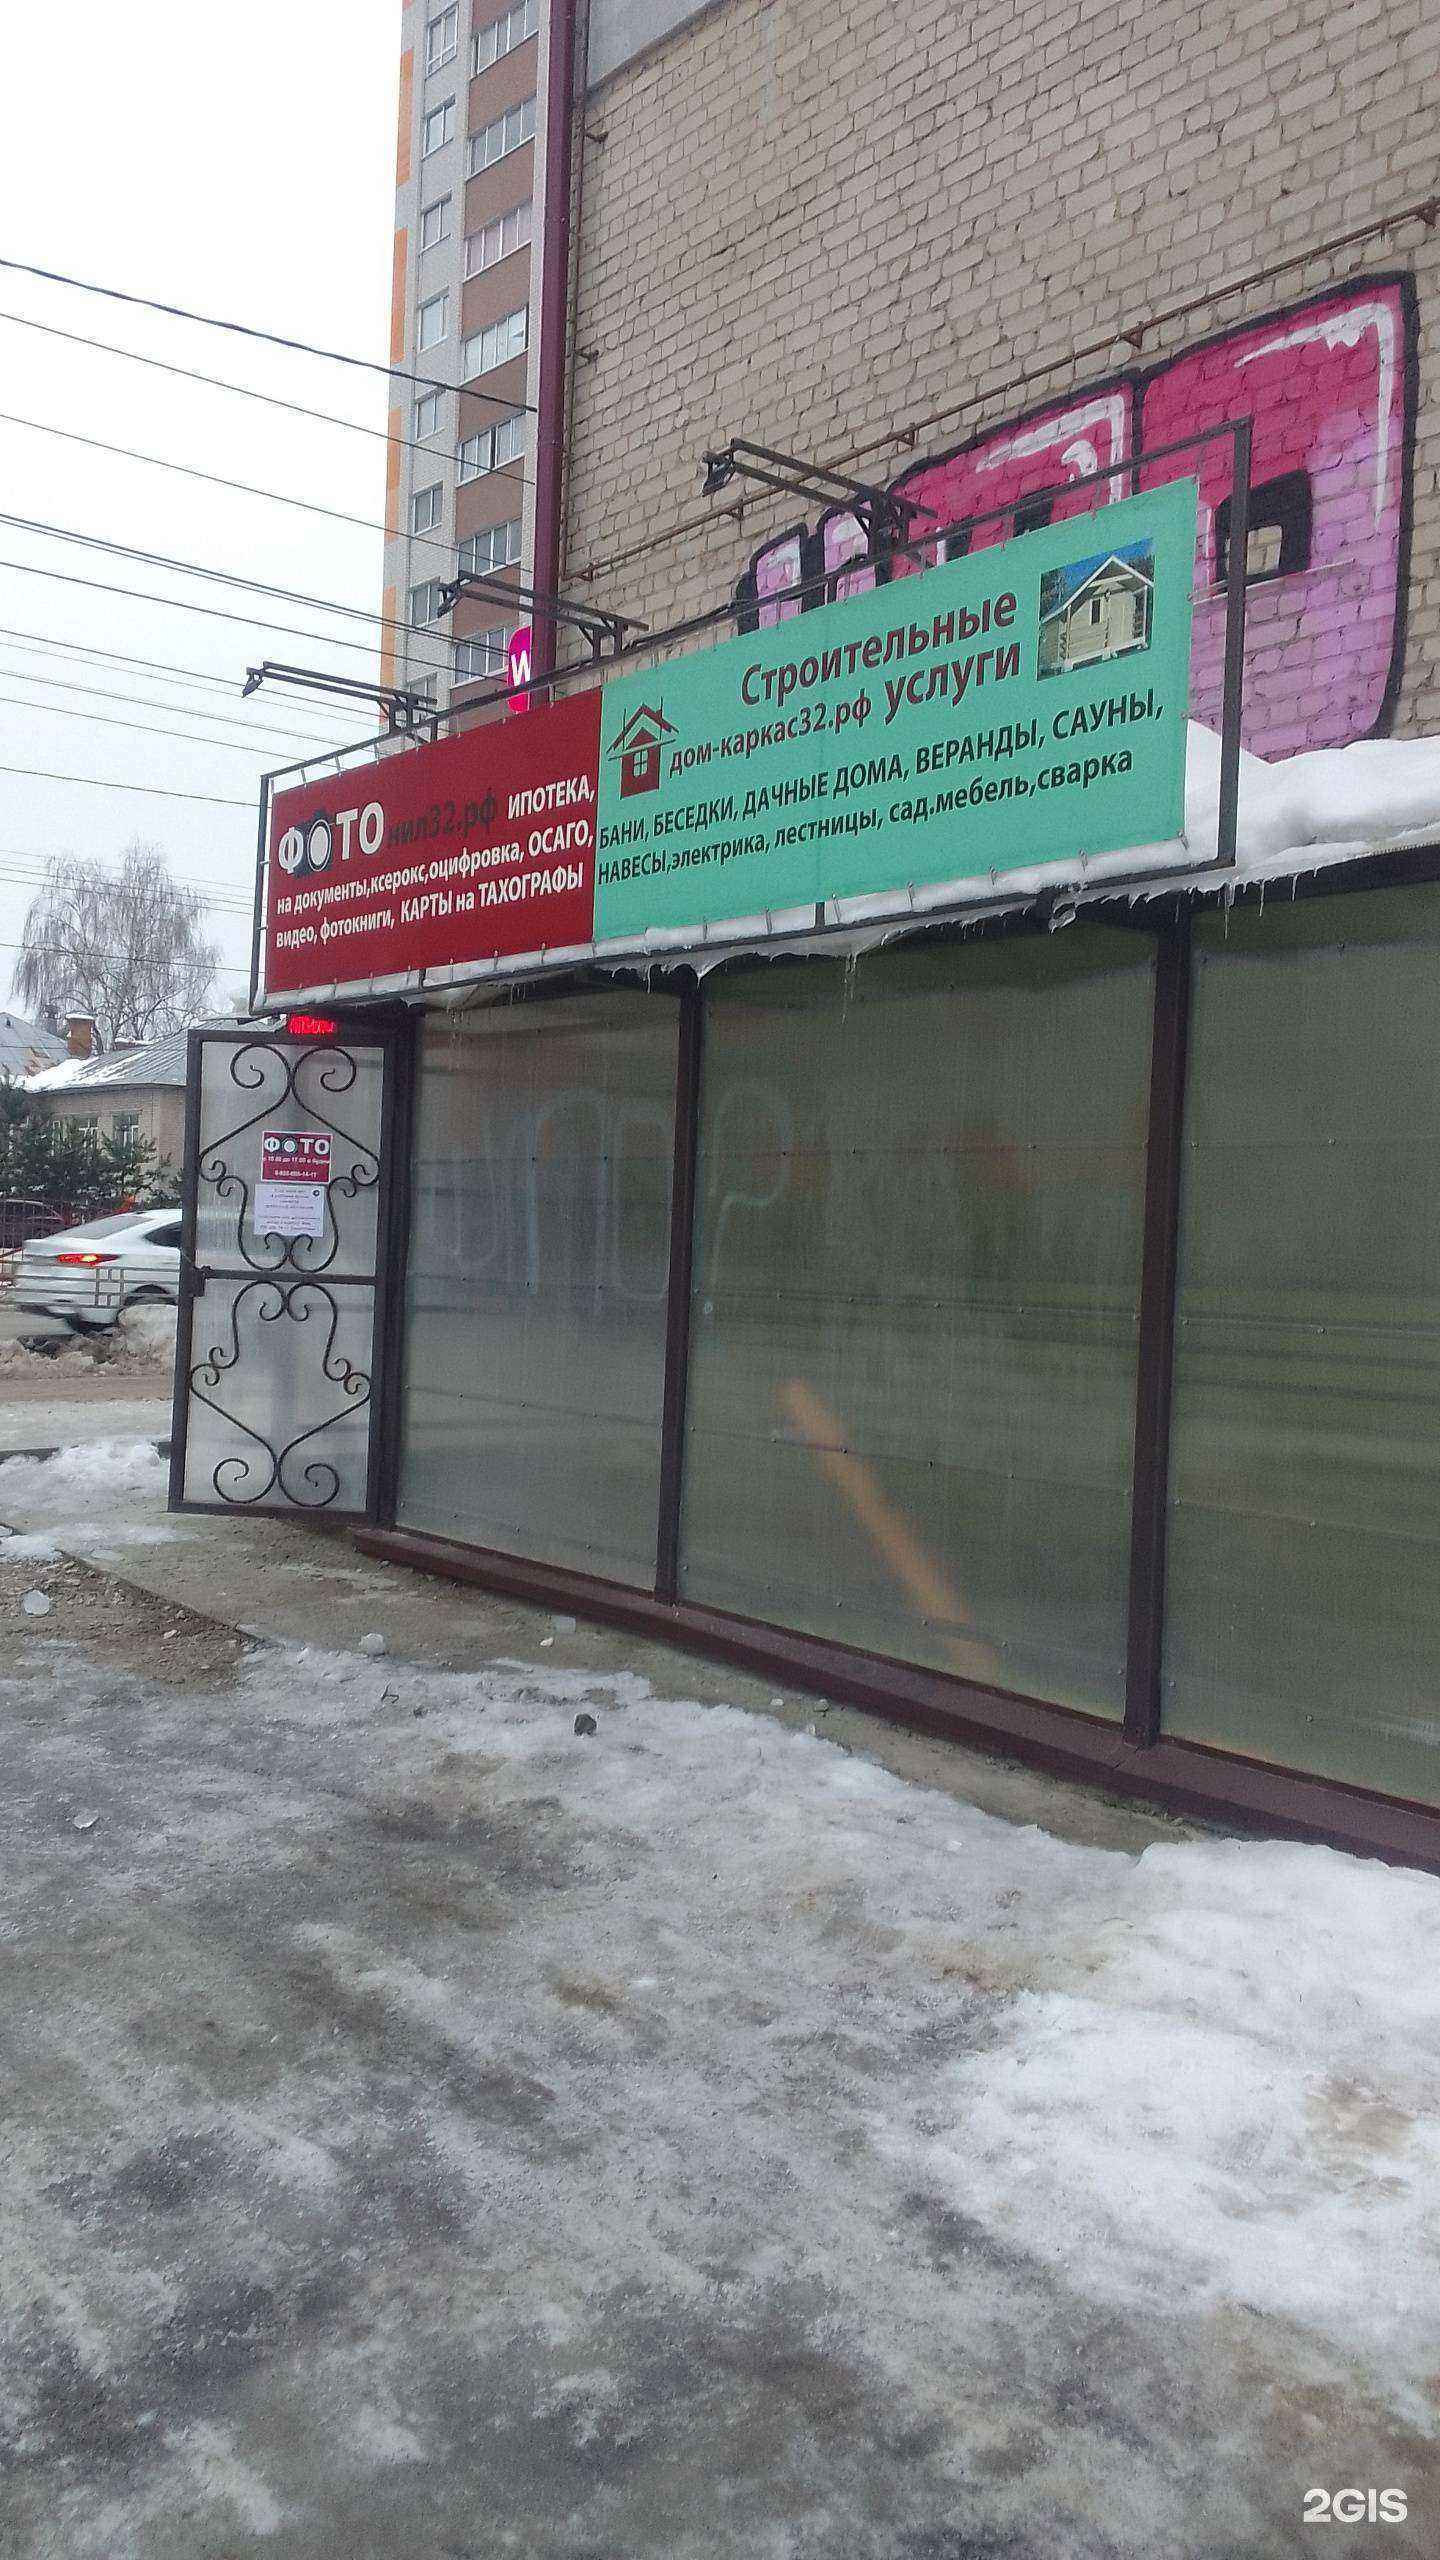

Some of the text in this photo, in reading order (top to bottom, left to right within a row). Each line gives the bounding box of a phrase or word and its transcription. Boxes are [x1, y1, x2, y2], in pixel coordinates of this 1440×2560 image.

[741, 591, 1018, 707] Строительные
[669, 641, 1021, 777] дом-каркас32.рф услуги
[599, 688, 1164, 850] БАНИ, БЕСЕДКИ, ДАЧНЫЕ ДОМА, ВЕРАНДЫ, САУНЫ,
[276, 896, 292, 915] на
[528, 819, 594, 857] ОСАГО,
[277, 801, 385, 875] ФОТО
[507, 774, 595, 820] ИПОТЕКА,
[775, 808, 882, 848] лестницы,
[276, 862, 584, 949] видео, фотокниги, КАРТЫ на ТАХОГРАФЫ
[264, 1136, 330, 1155] ФОТО
